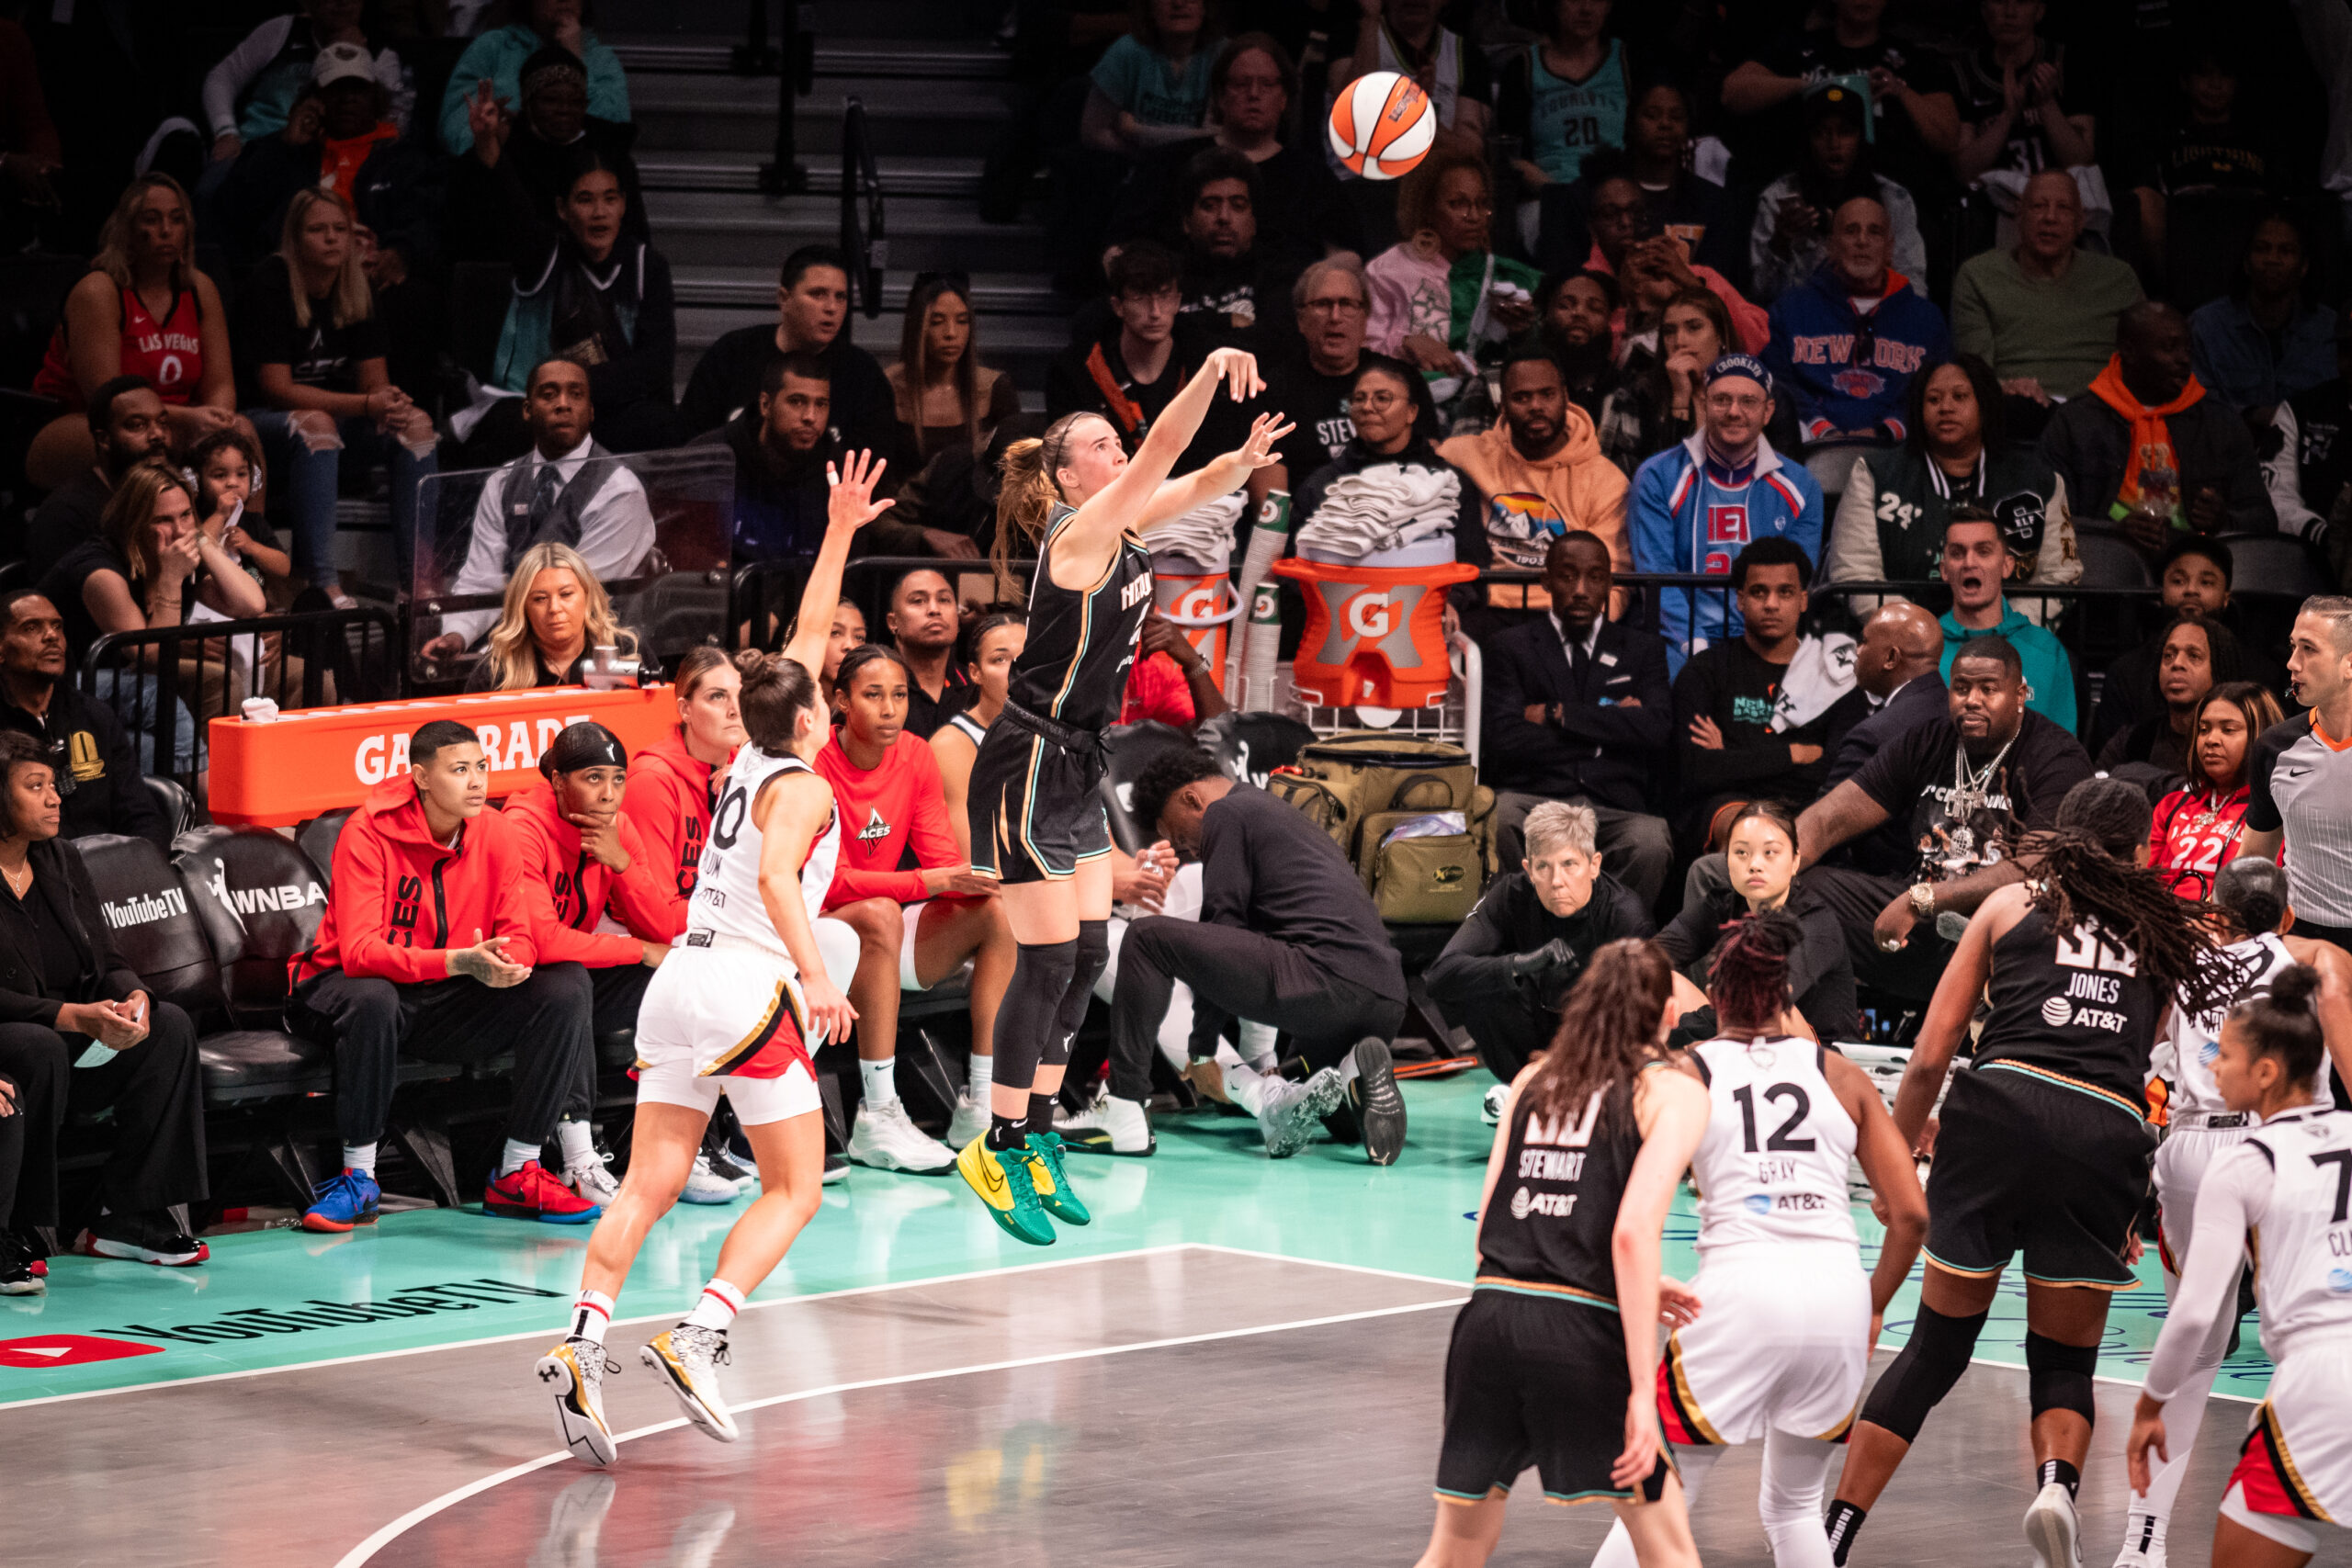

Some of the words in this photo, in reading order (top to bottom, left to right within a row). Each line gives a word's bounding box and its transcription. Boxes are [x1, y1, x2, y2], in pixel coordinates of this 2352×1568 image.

[1563, 117, 1599, 146] 20
[138, 333, 163, 354] LAS
[164, 333, 199, 355] VEGAS
[1792, 334, 1855, 365] NEW
[1861, 338, 1927, 374] ORK
[158, 354, 183, 386] 0
[1181, 589, 1214, 619] G
[1350, 593, 1389, 637] G
[355, 716, 592, 785] GARAD
[857, 826, 891, 840] ACES
[2171, 836, 2223, 873] 22
[232, 881, 329, 915] WNBA
[2064, 972, 2120, 1004] JONES
[2073, 1007, 2128, 1033] AT&T
[1733, 1082, 1815, 1153] 12
[1518, 1149, 1587, 1182] STEWART
[1528, 1192, 1578, 1217] AT&T
[1778, 1193, 1826, 1211] AT&T
